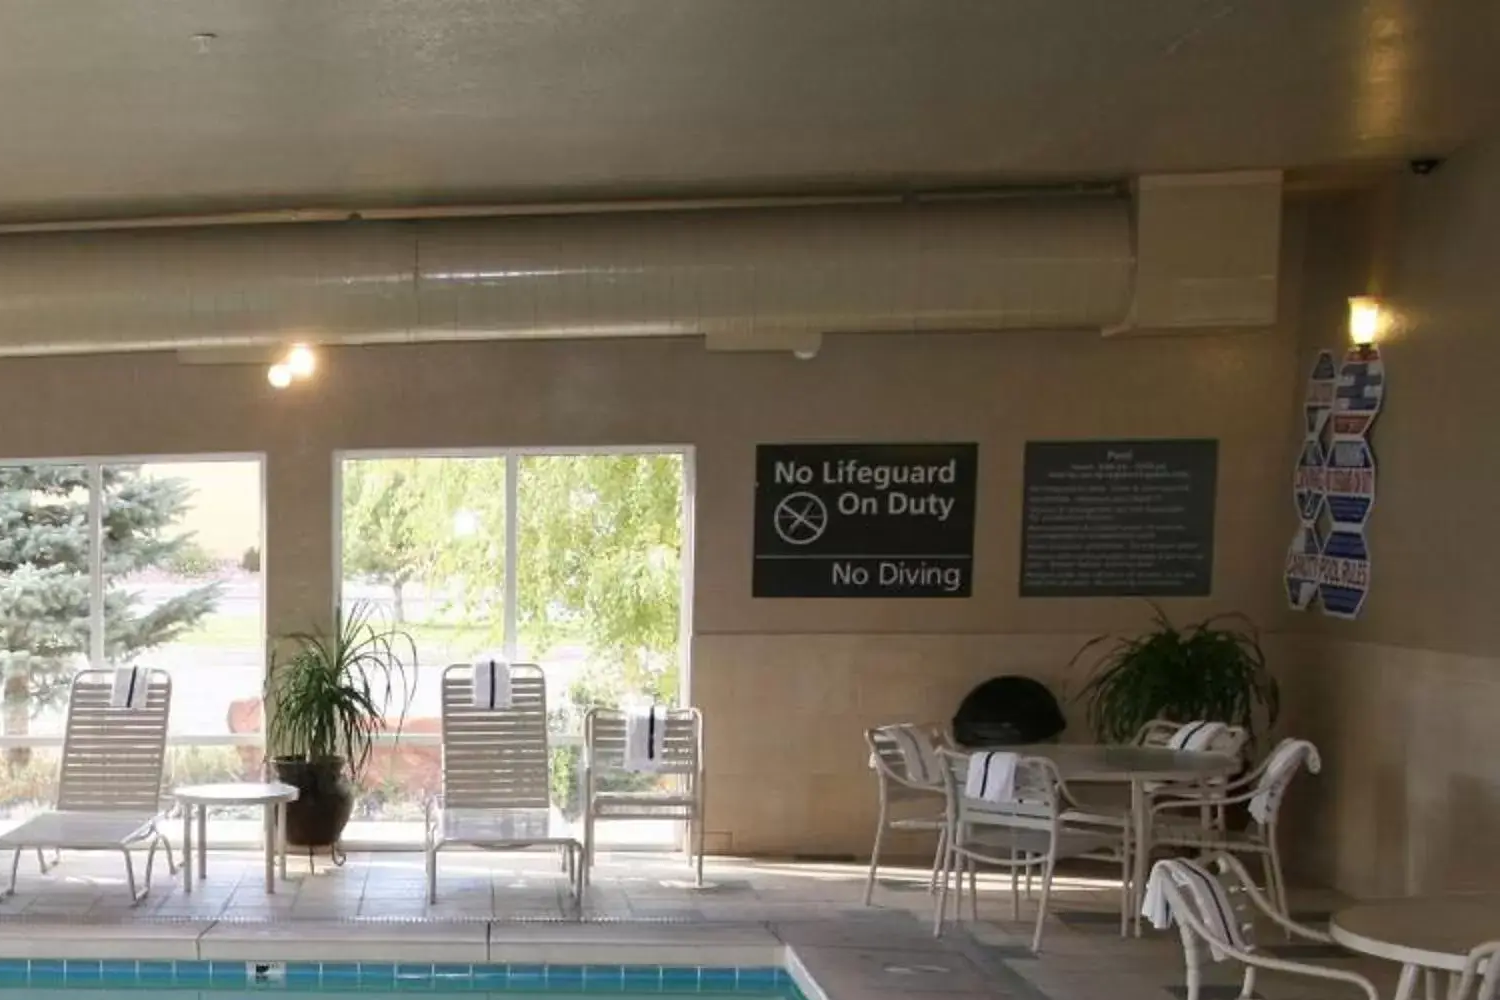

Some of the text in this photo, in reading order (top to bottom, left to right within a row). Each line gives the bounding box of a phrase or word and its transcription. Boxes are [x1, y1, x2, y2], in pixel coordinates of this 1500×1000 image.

[774, 459, 956, 490] No Lifeguard
[838, 491, 955, 521] On Duty
[832, 560, 961, 591] No Diving
